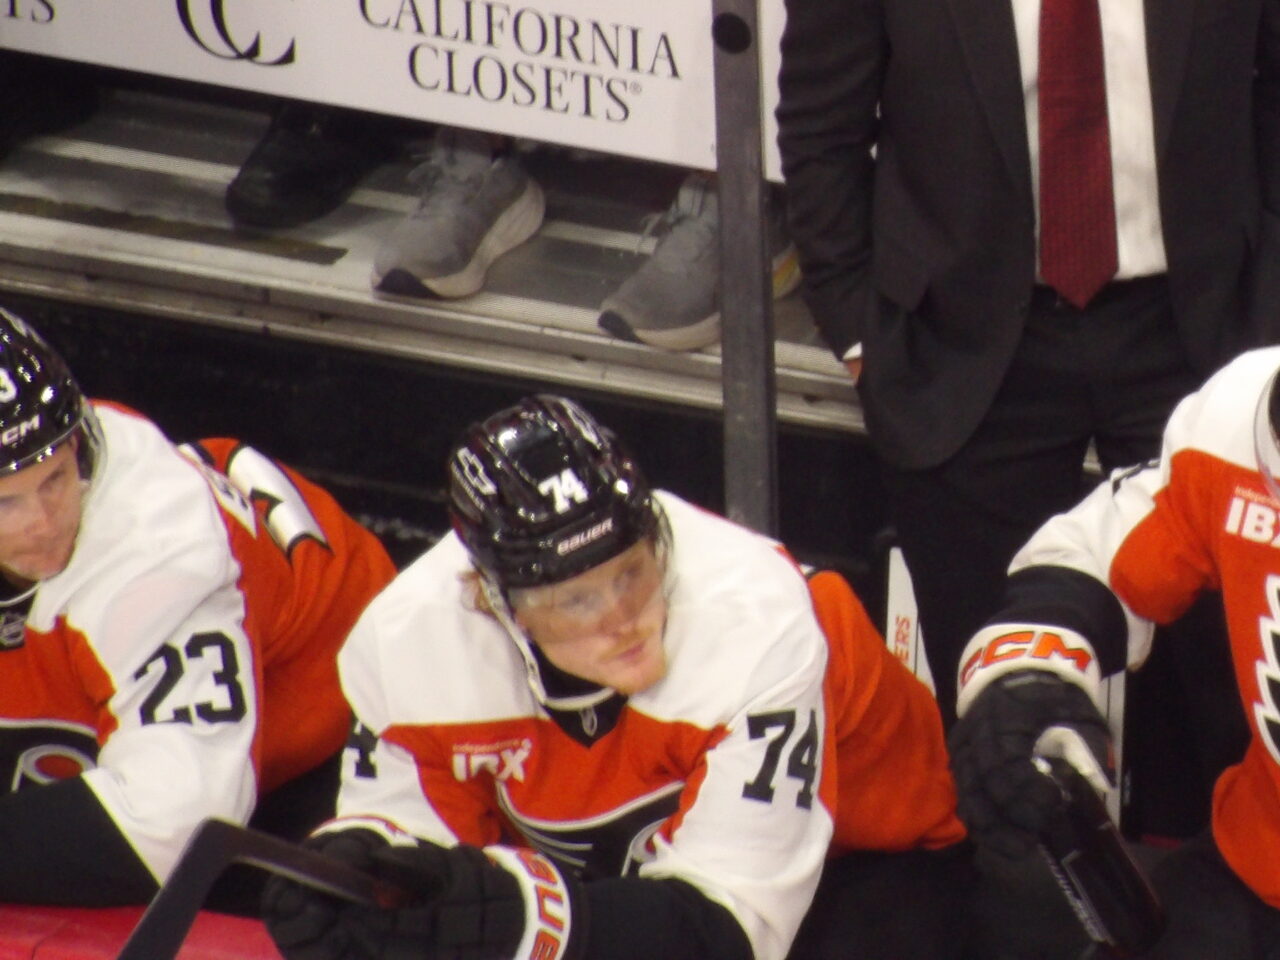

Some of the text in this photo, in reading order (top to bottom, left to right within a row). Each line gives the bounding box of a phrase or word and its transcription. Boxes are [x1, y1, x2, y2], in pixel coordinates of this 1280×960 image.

[1, 414, 41, 445] CM
[537, 468, 589, 515] 74
[556, 517, 614, 557] BAUER
[132, 630, 248, 727] 23
[741, 707, 819, 811] 74
